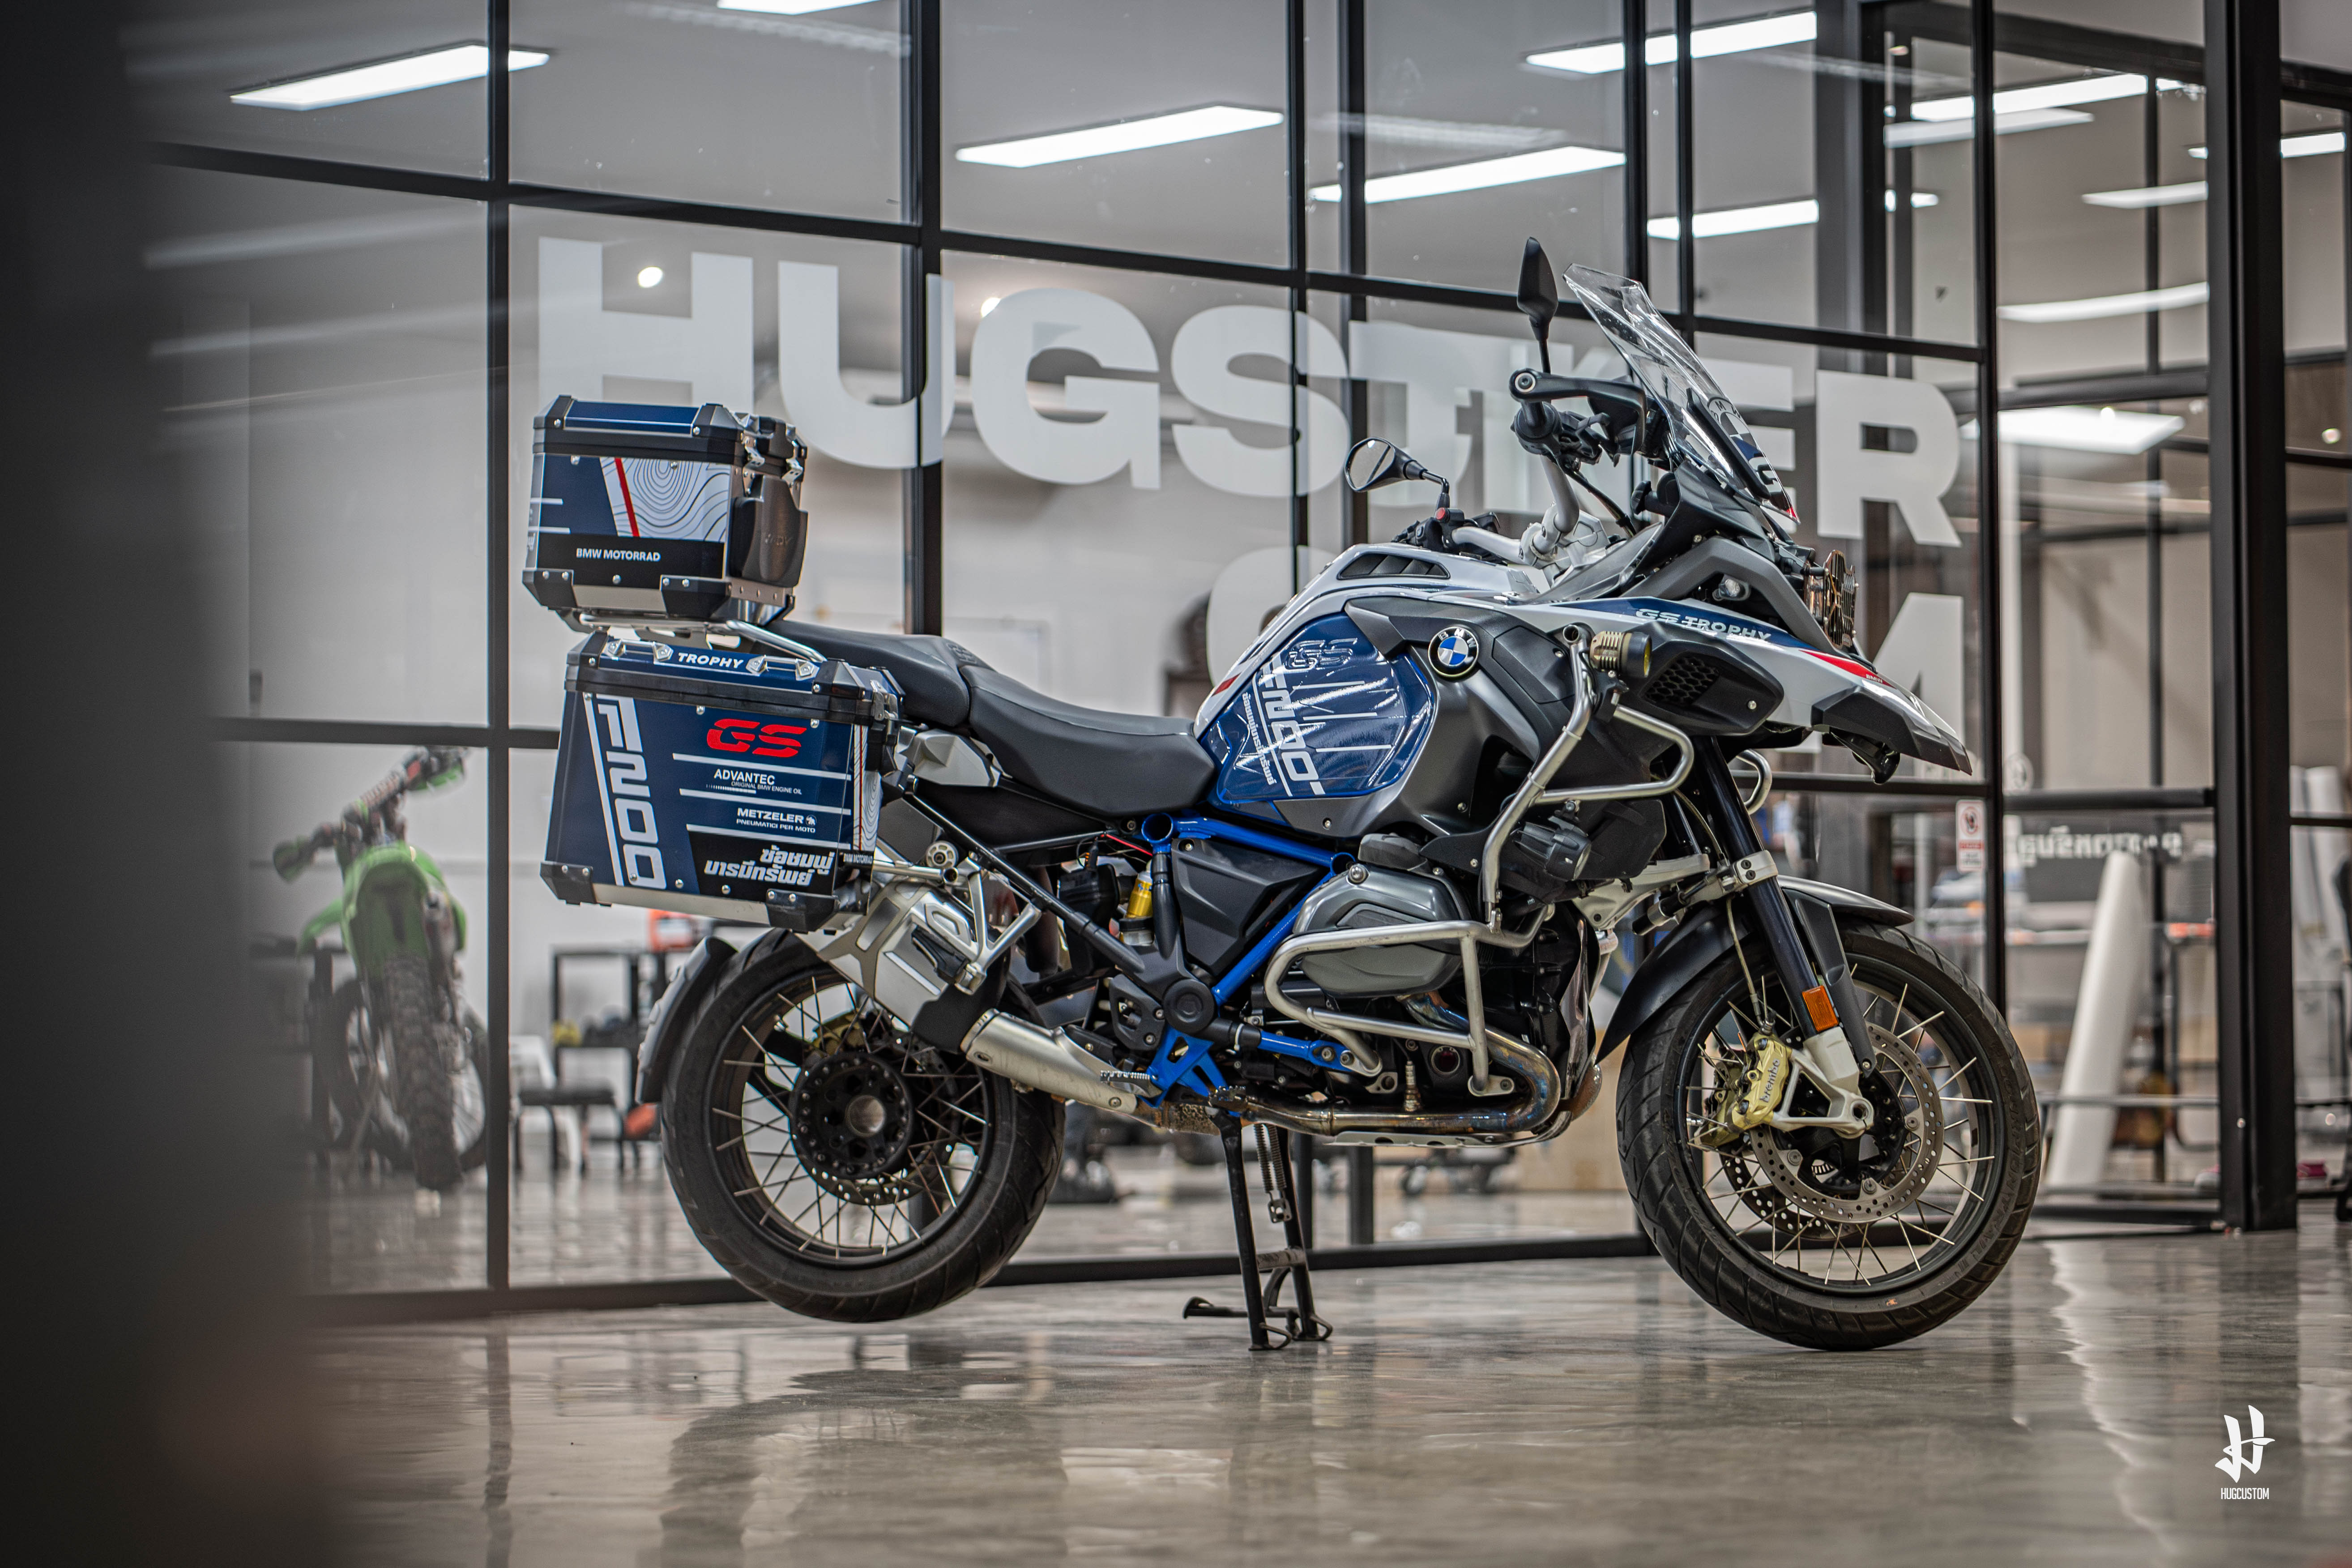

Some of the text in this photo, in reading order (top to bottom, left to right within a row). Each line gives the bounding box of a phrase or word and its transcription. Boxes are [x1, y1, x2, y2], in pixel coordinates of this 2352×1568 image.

[576, 548, 661, 562] BMW MOTORRAD
[1635, 608, 1771, 641] GS TROPHY
[1438, 628, 1477, 648] BMW
[678, 652, 744, 669] TROPHY
[1865, 674, 1883, 684] BMW
[707, 718, 807, 758] GS
[713, 769, 776, 785] ADVANTEC
[731, 780, 756, 789] ORIGINAL
[757, 783, 771, 791] BMW
[772, 785, 792, 794] ENGINE
[737, 807, 804, 824] METZELER
[736, 818, 815, 833] PNEUMATICI PER MOTO
[1759, 1058, 1780, 1103] brembo
